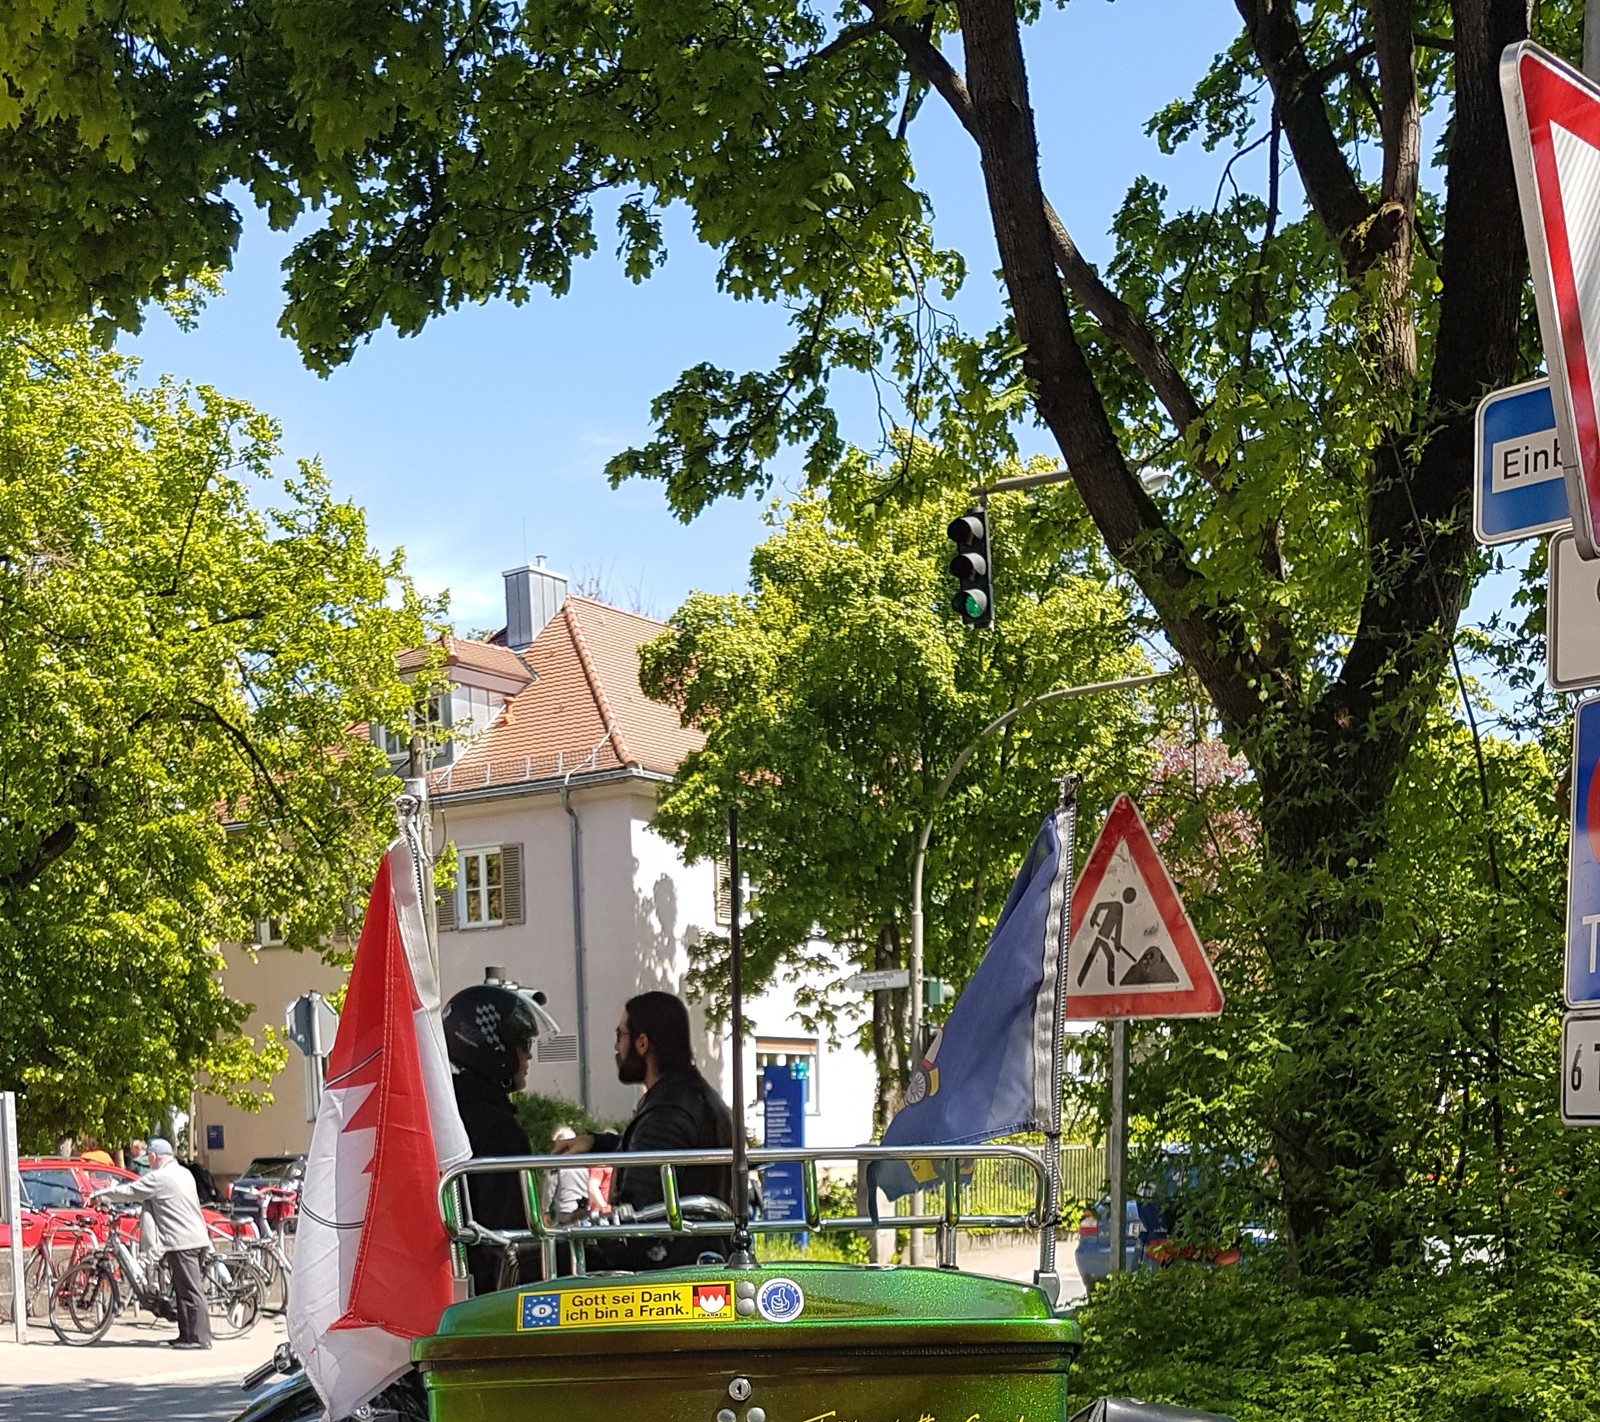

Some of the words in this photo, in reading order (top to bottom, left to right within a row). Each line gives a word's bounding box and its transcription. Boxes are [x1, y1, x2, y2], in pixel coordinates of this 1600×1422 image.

[571, 1293, 608, 1307] Gott
[612, 1291, 635, 1305] sei
[641, 1290, 682, 1304] Dank
[565, 1307, 589, 1322] ich
[595, 1306, 619, 1320] bin
[624, 1308, 634, 1319] a
[639, 1303, 690, 1317] Frank.
